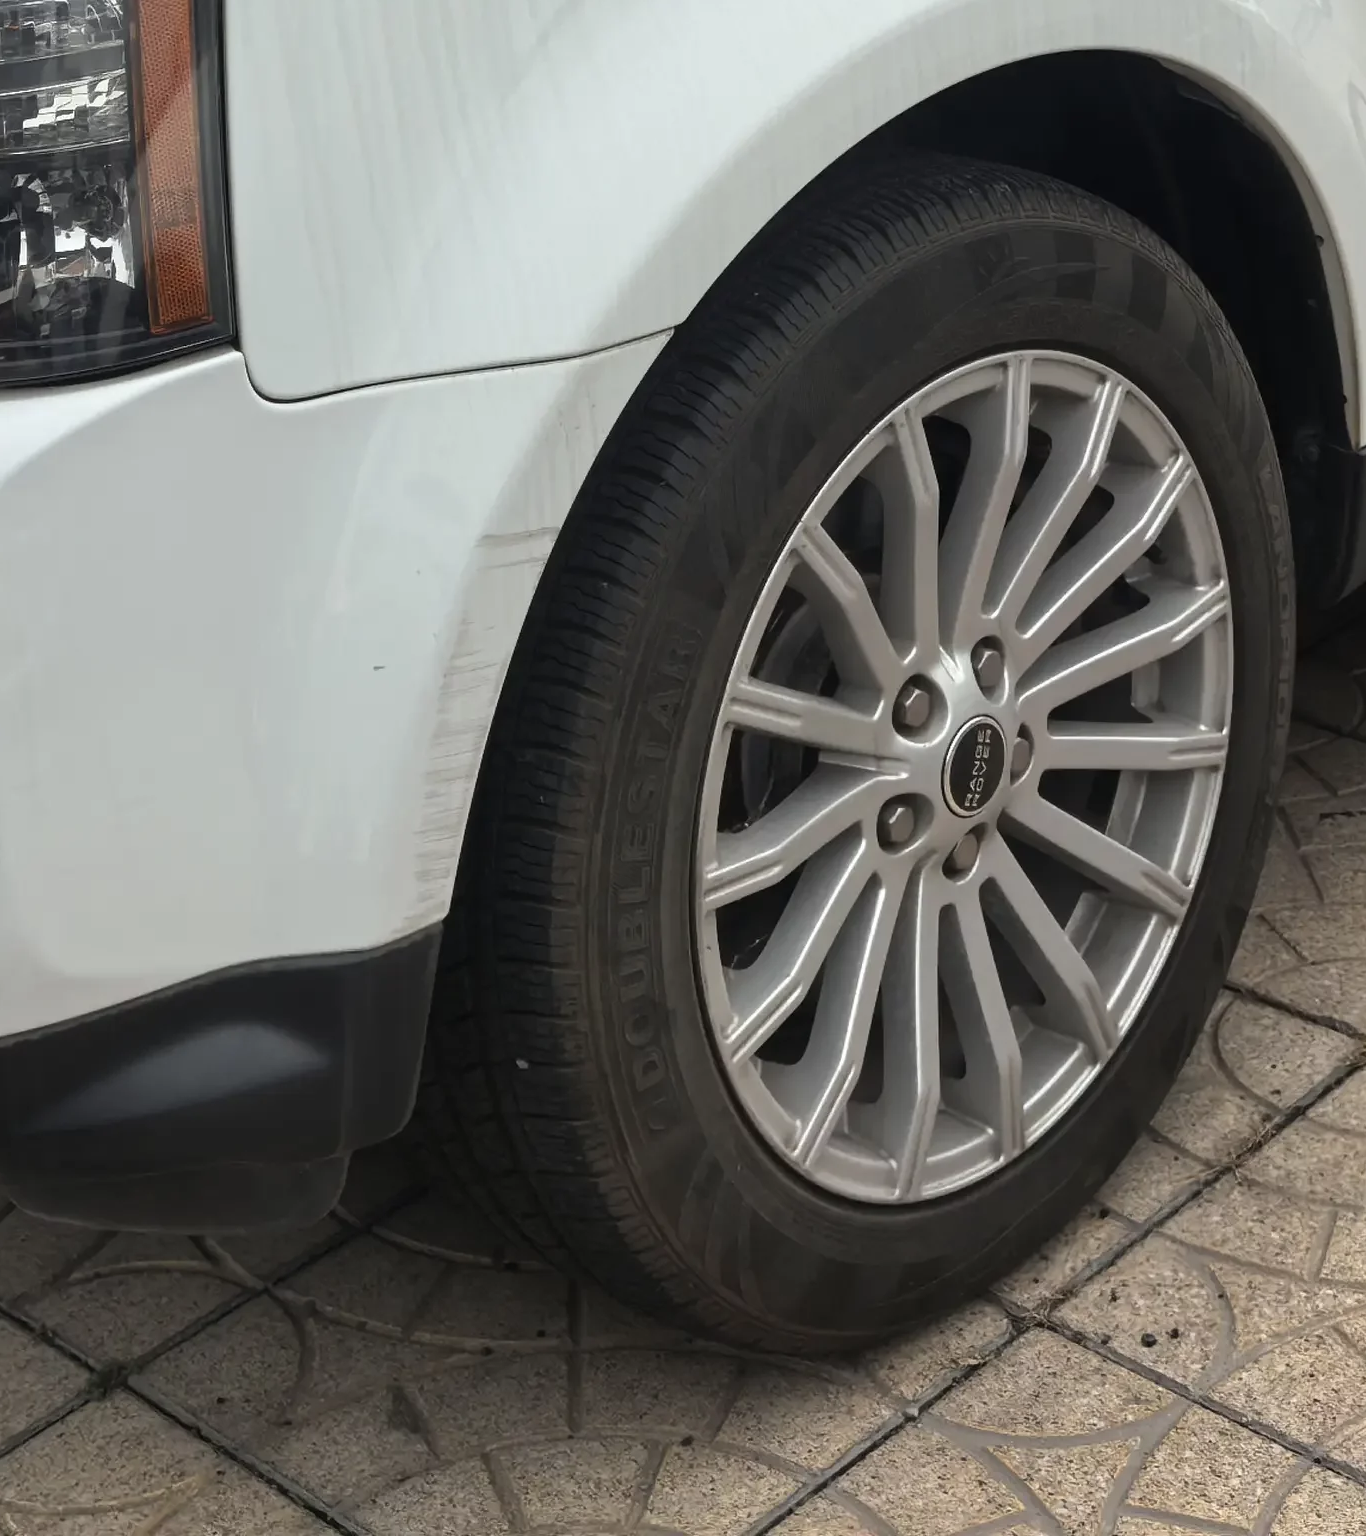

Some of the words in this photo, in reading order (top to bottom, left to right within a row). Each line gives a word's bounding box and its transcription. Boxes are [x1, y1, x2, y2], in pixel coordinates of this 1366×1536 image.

[965, 729, 985, 806] RANGE
[971, 729, 992, 806] ROVER
[616, 624, 703, 1094] DOUBLESTAR
